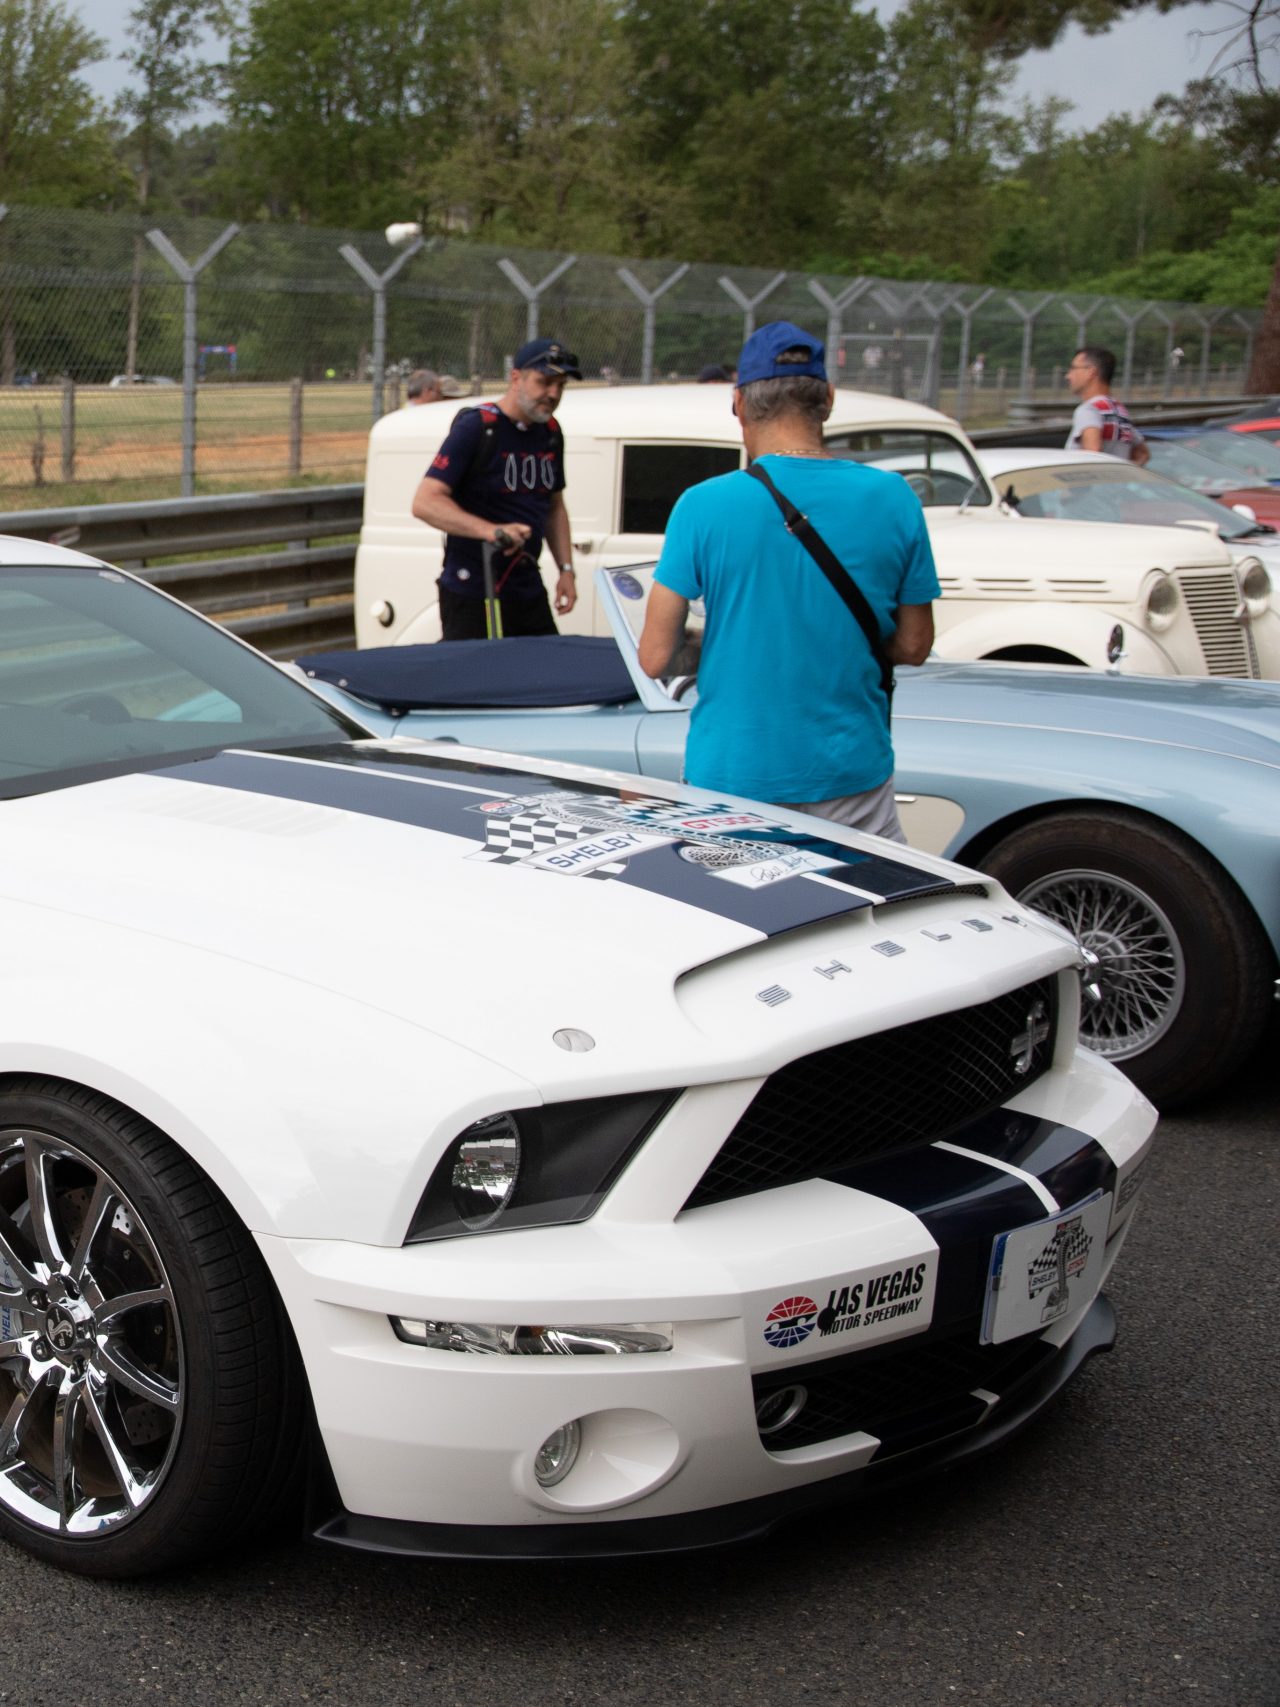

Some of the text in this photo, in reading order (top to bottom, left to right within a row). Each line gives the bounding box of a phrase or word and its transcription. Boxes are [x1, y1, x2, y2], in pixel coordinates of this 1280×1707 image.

[546, 833, 642, 868] SHELBY
[827, 1263, 926, 1317] LAS VEGAS
[863, 1297, 923, 1326] SPEEDWAY
